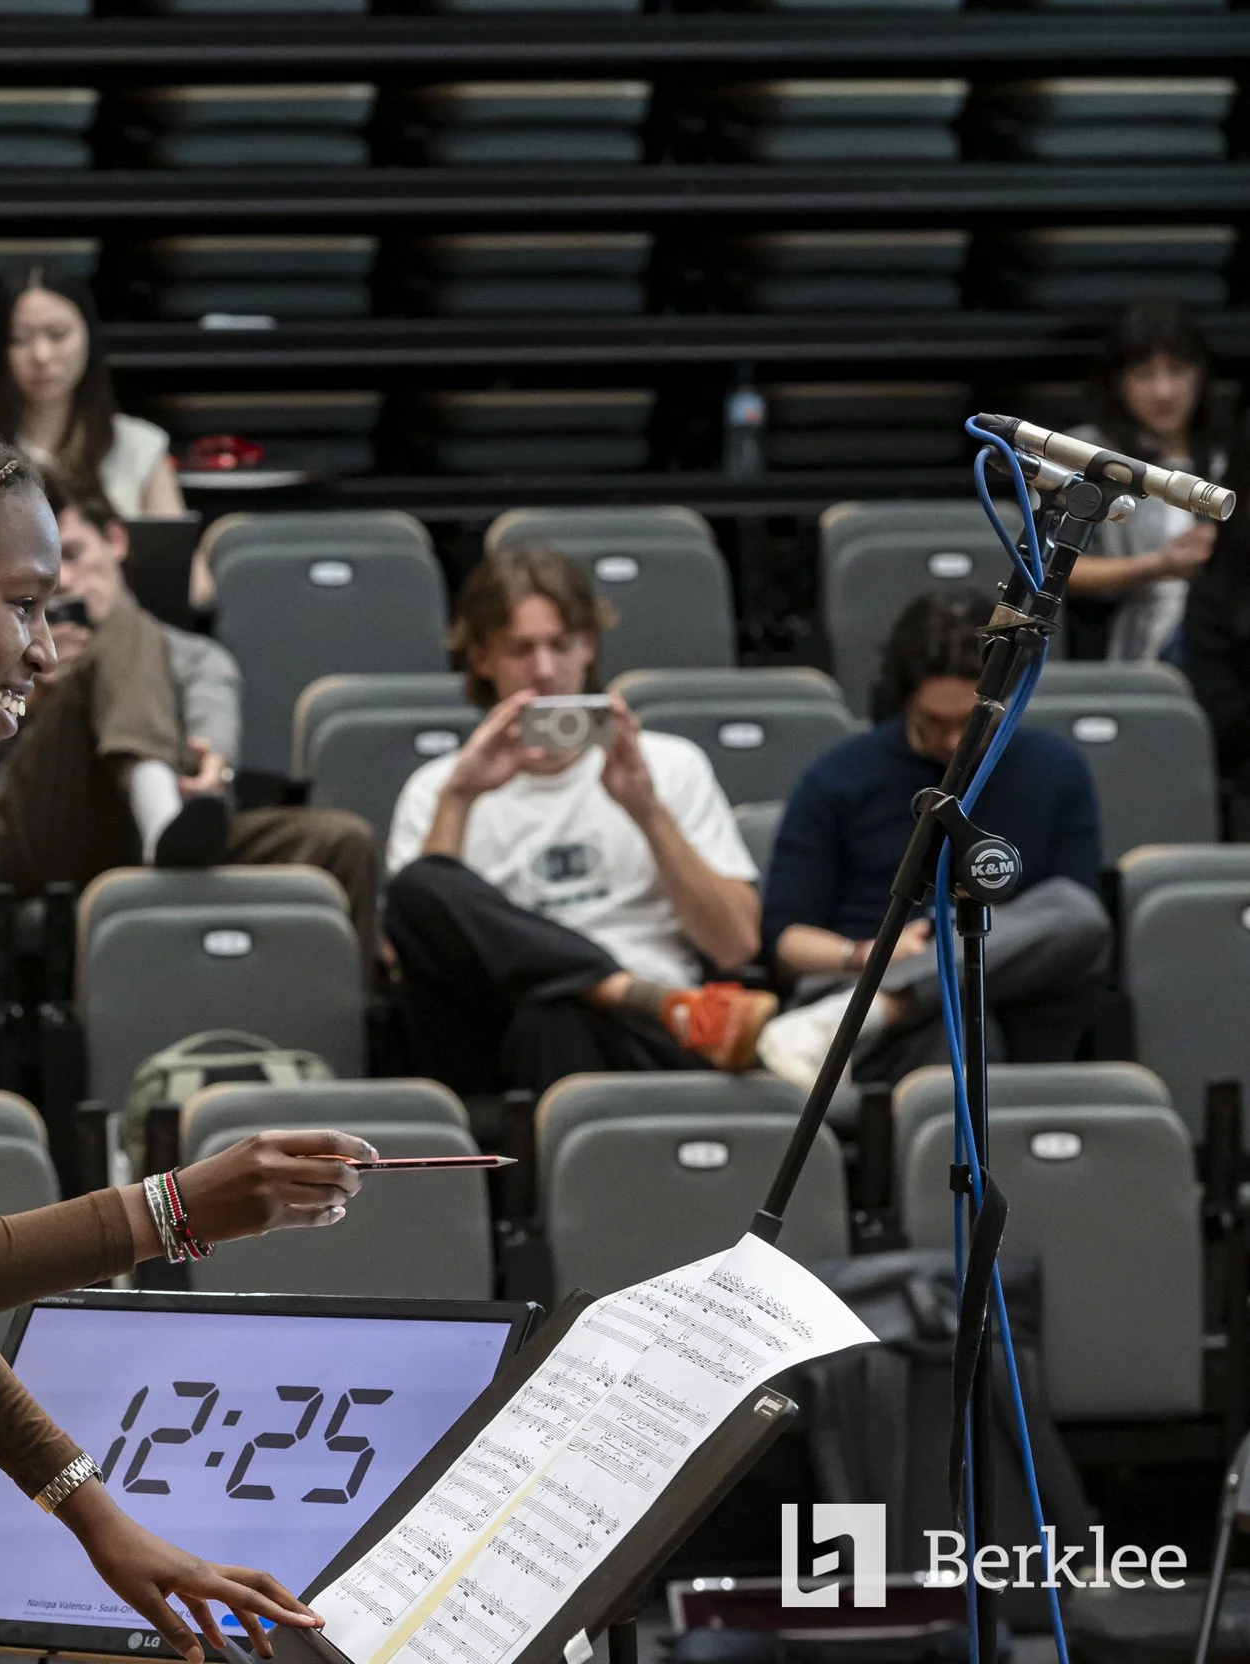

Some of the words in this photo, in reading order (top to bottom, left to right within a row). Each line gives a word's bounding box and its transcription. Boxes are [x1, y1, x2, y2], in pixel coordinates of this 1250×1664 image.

[971, 861, 1014, 877] K&M
[100, 1381, 394, 1504] 12:25
[27, 1599, 57, 1609] Nailspa
[59, 1600, 92, 1611] Valencia
[143, 1636, 161, 1648] LG
